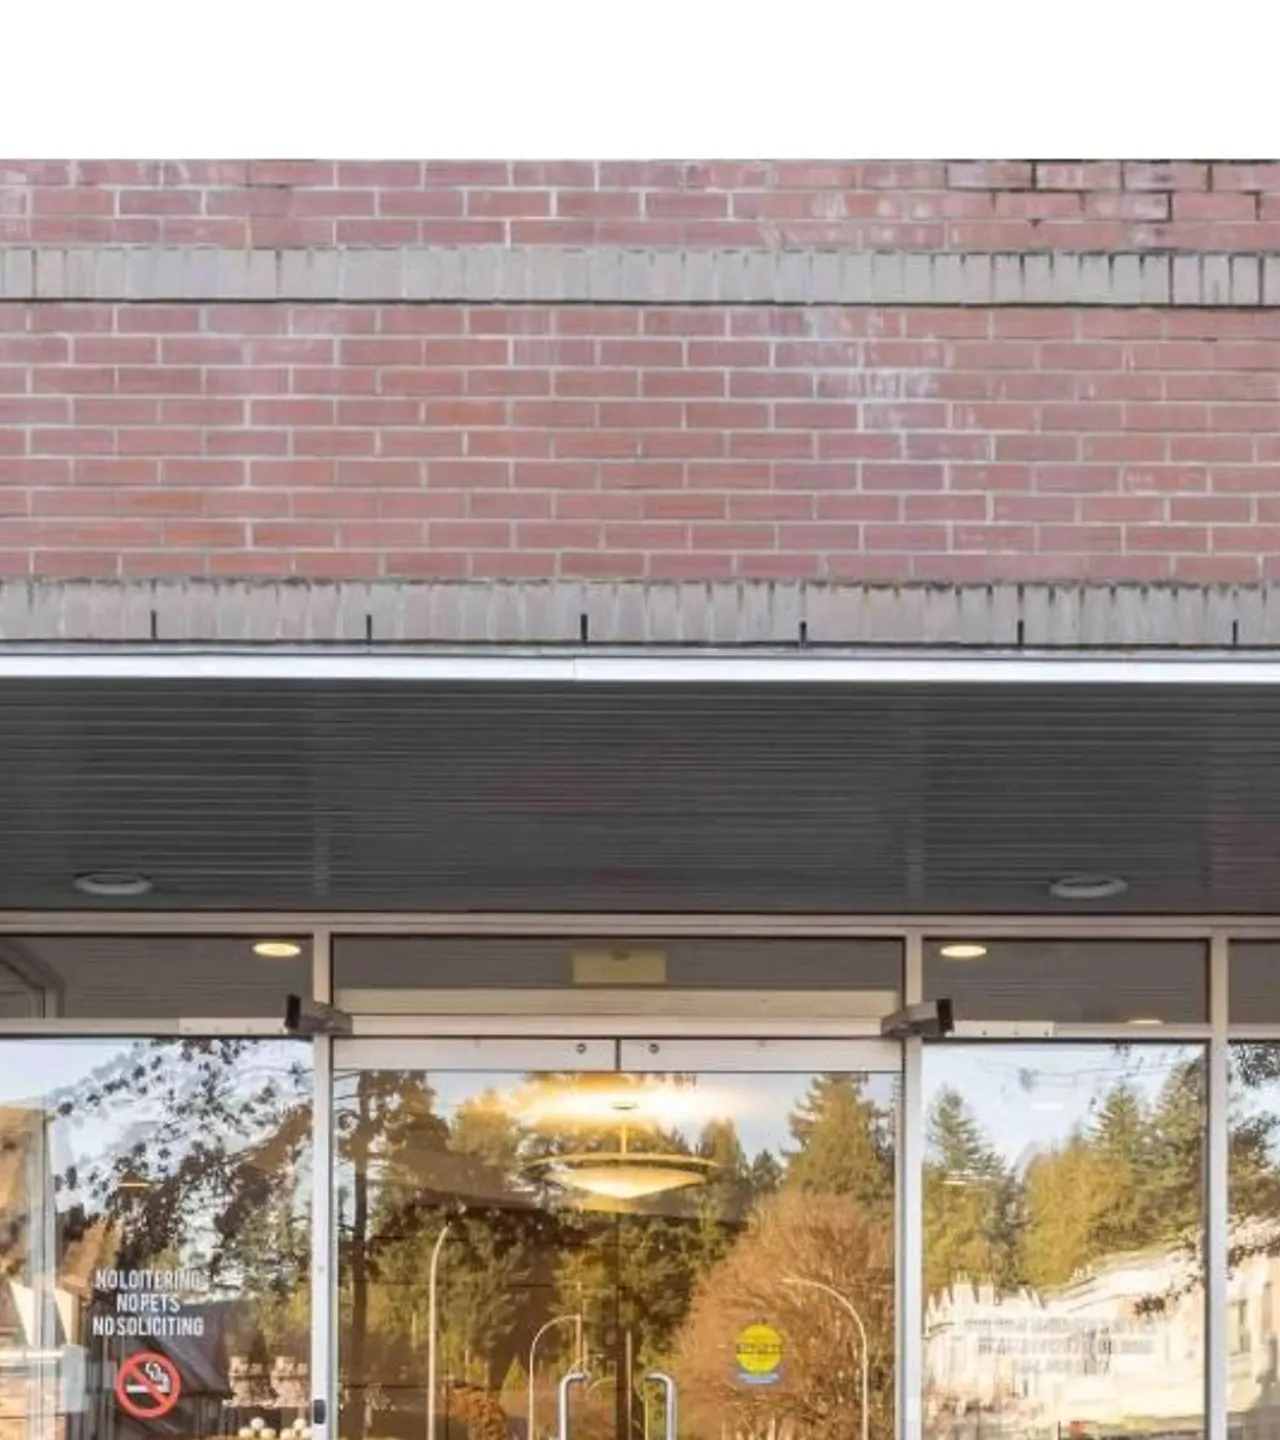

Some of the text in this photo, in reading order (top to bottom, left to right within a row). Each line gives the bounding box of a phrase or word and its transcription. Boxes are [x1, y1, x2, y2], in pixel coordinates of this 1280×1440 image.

[140, 1293, 180, 1313] PETS
[93, 1316, 205, 1336] NO SOLICITING
